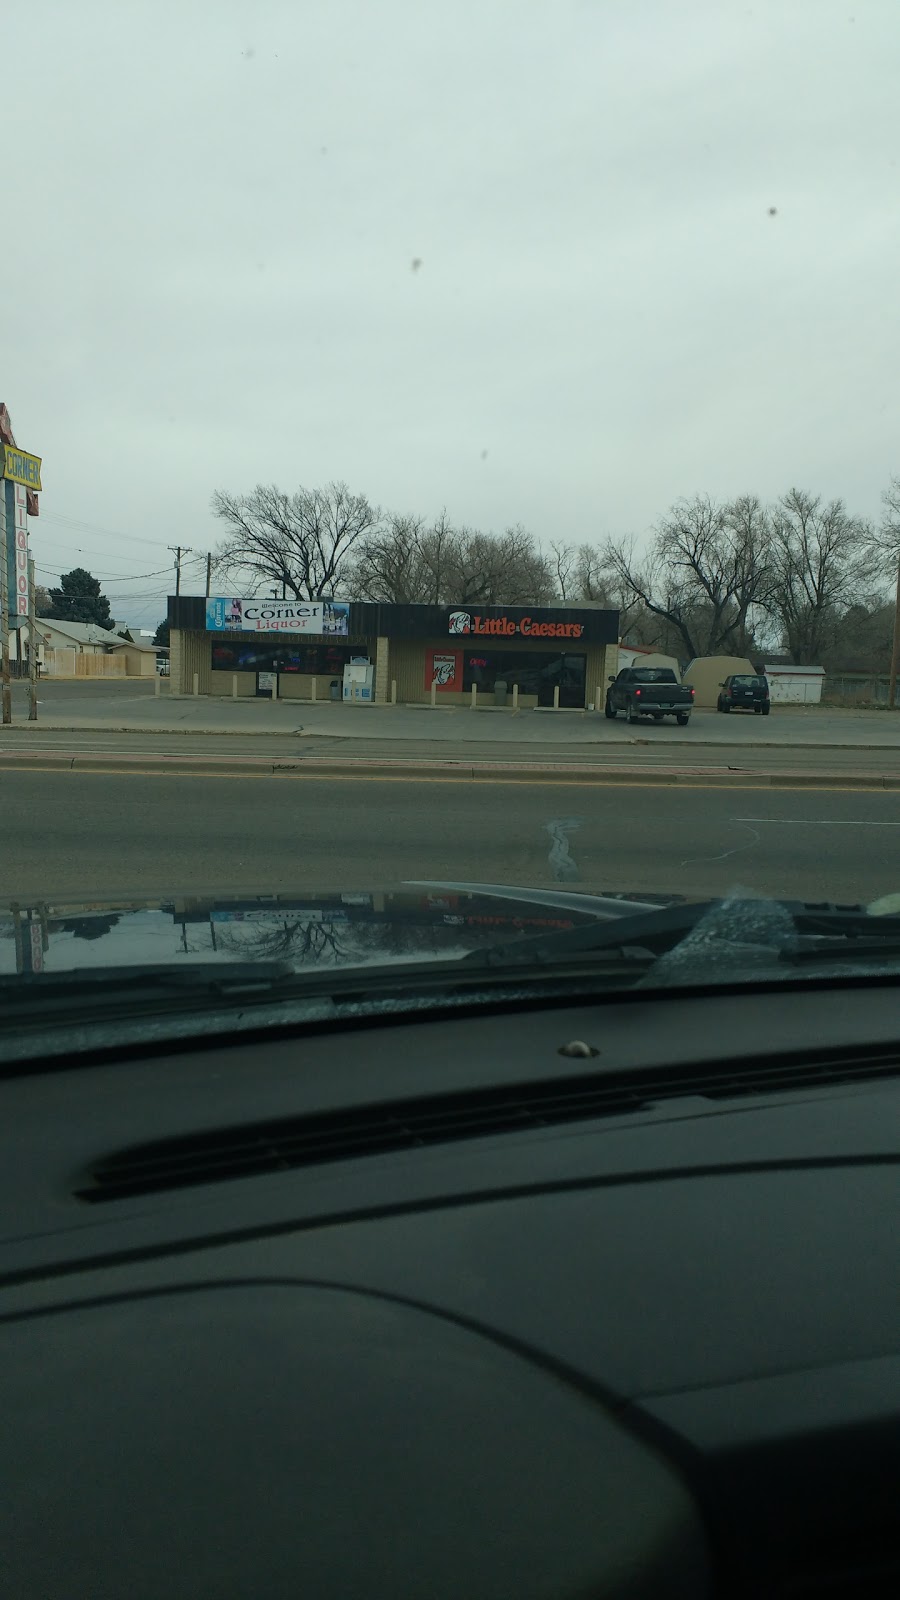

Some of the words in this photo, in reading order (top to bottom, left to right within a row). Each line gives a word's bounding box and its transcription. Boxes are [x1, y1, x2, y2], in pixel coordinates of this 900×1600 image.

[7, 450, 39, 485] CORNER
[16, 486, 27, 614] LIQUOR
[214, 602, 223, 627] Corona
[244, 607, 320, 620] Corner
[256, 619, 308, 630] Liquor
[473, 616, 516, 636] Little
[519, 617, 582, 638] Caesars
